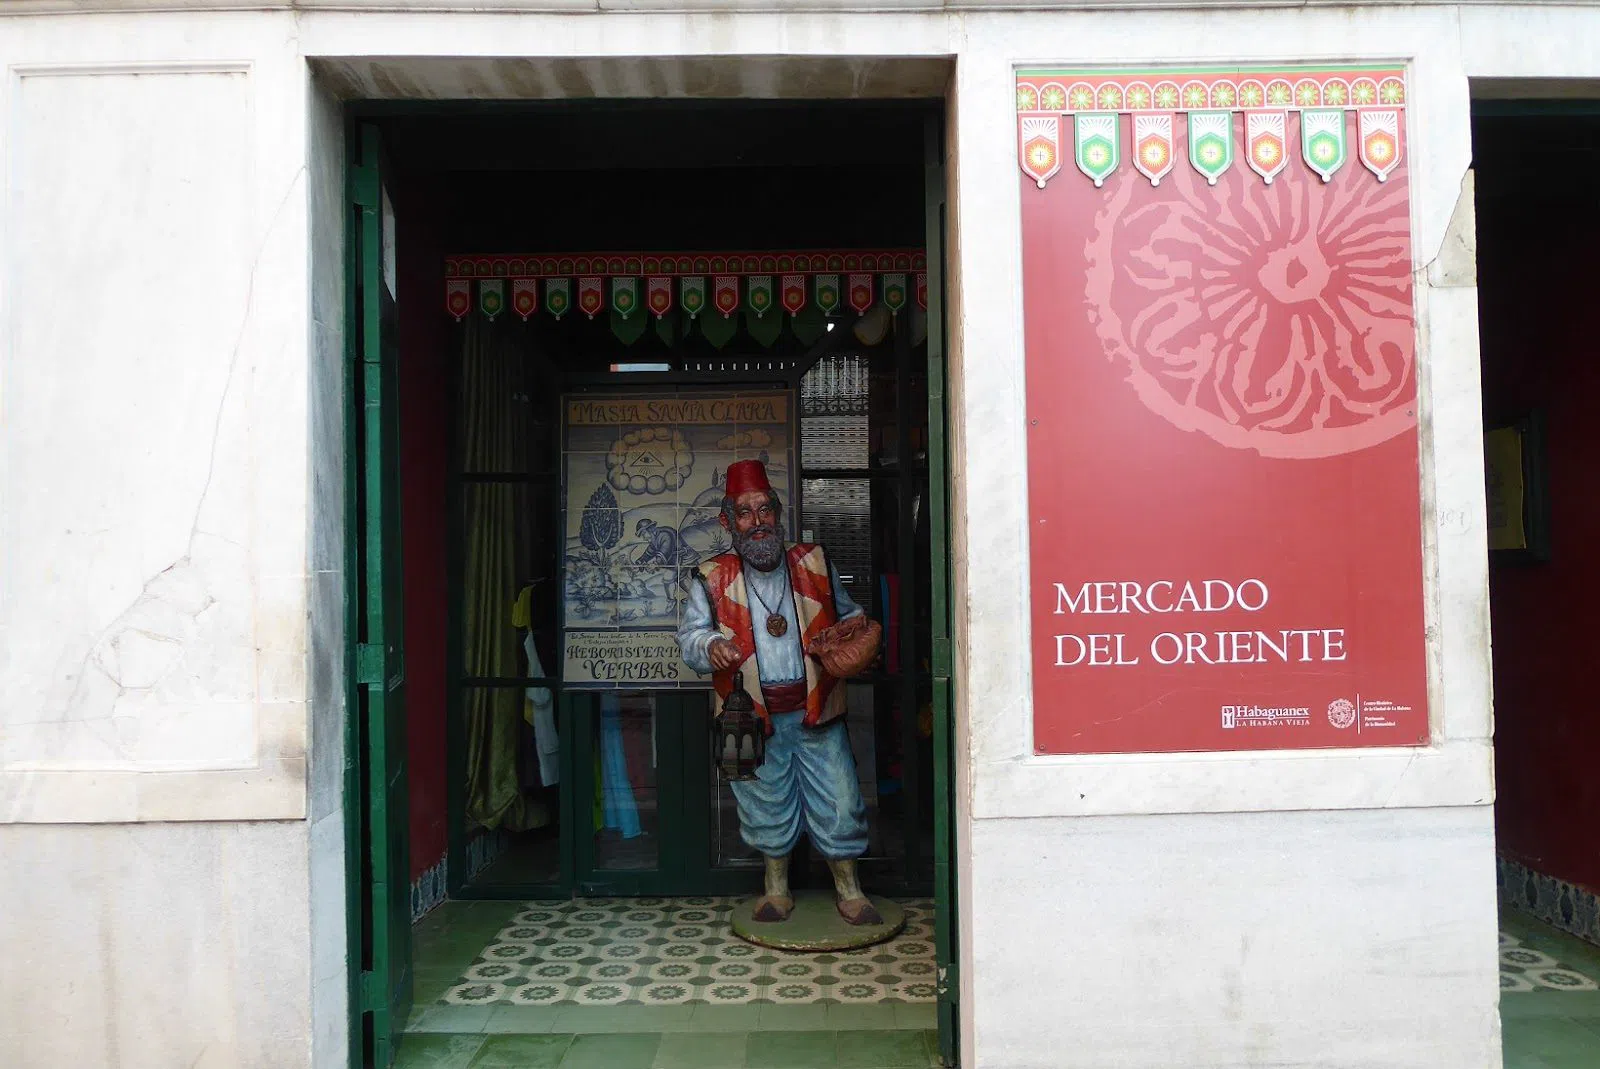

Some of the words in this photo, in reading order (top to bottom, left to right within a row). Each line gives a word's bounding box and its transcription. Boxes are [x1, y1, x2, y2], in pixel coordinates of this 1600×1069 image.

[573, 400, 641, 423] MASIA
[647, 400, 707, 422] SANTA
[711, 399, 777, 421] CLARA
[1053, 578, 1269, 614] MERCADO
[1054, 633, 1139, 666] DEL
[1150, 628, 1347, 665] ORIENTE
[583, 659, 679, 680] YERBAS
[1236, 705, 1310, 720] Habaguanex
